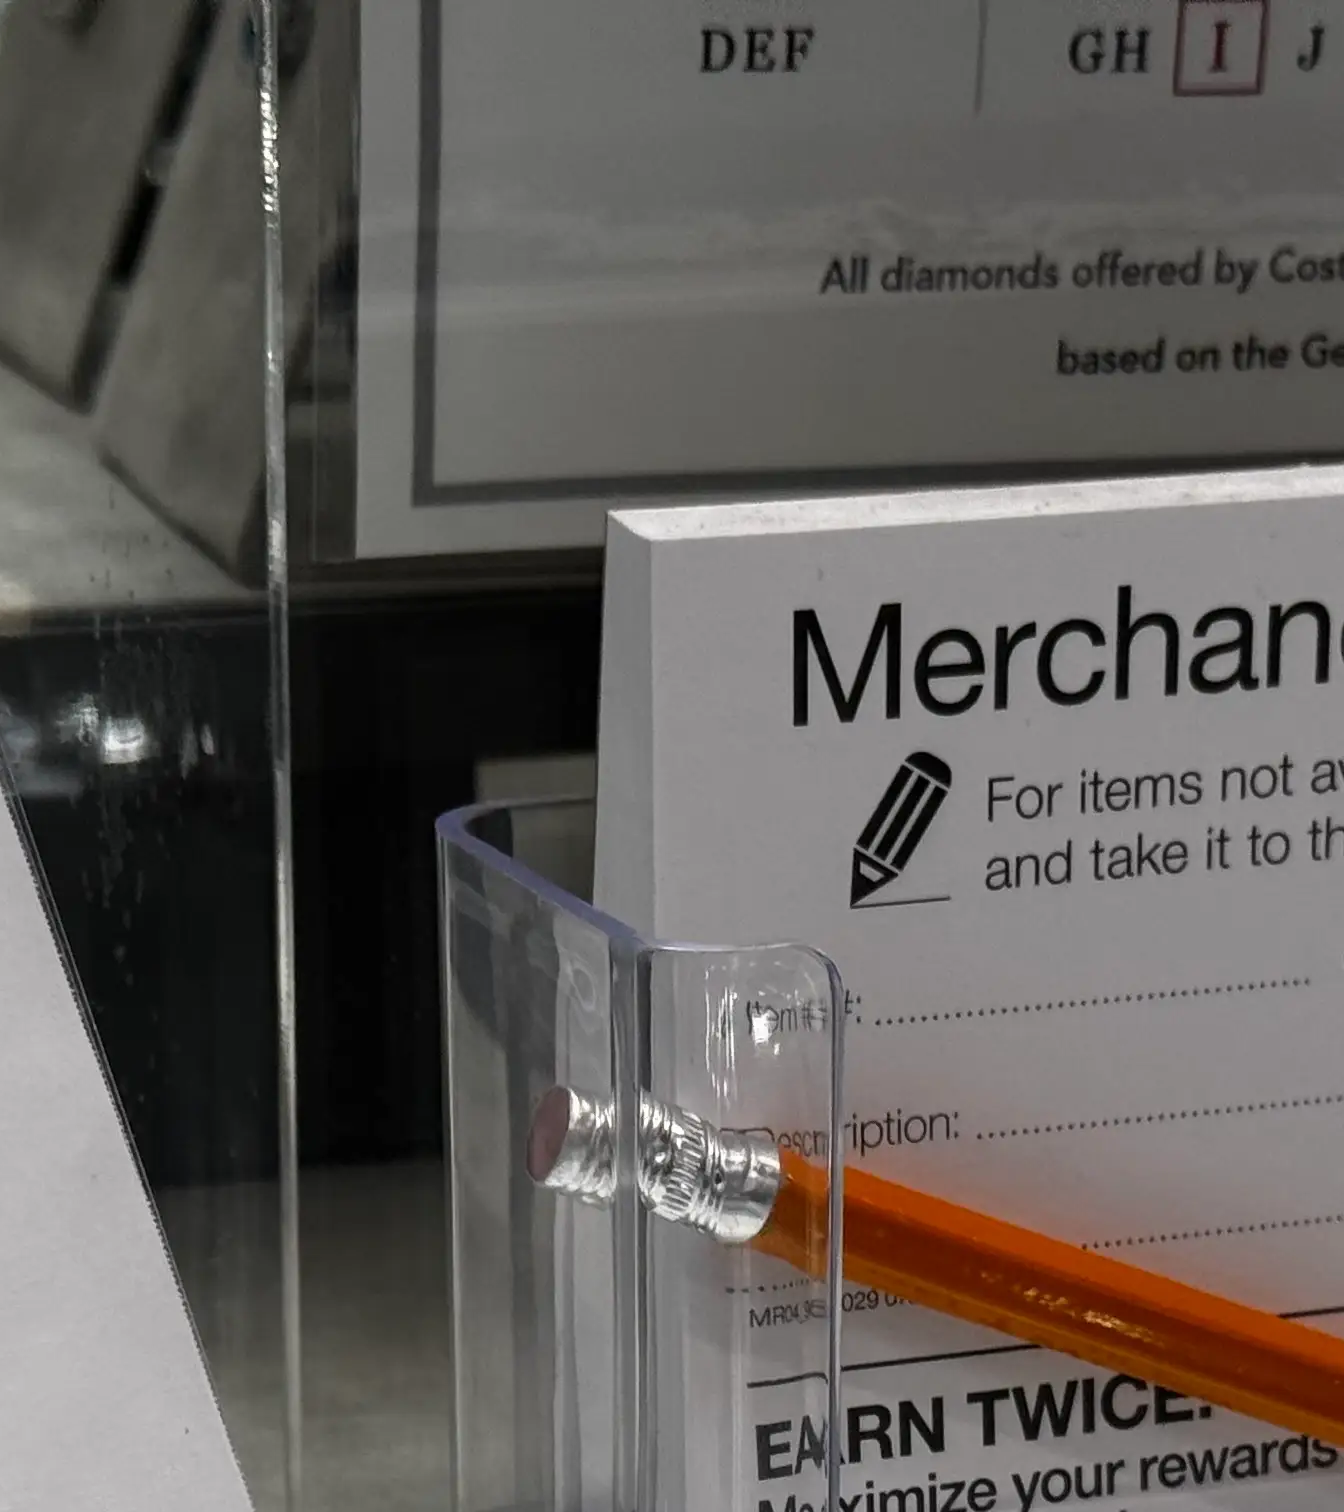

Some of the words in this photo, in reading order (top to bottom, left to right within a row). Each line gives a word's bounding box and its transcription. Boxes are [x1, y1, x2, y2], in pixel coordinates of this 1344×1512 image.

[700, 27, 815, 74] DEF
[1069, 27, 1151, 76] GH
[1297, 26, 1324, 73] J
[820, 254, 871, 294] All
[881, 251, 1060, 292] diamonds
[1072, 247, 1204, 288] offered
[1214, 248, 1259, 295] by
[1056, 336, 1166, 376] based
[1175, 344, 1222, 373] on
[1232, 333, 1292, 372] the
[988, 776, 1063, 823] For
[1080, 768, 1204, 814] items
[1221, 754, 1294, 802] not
[985, 838, 1072, 891] and
[1089, 832, 1188, 881] take
[1207, 826, 1231, 870] it
[1247, 825, 1291, 867] to
[756, 1396, 945, 1480] EARN
[967, 1373, 1212, 1446] TWICE.
[1139, 1434, 1340, 1490] rewards
